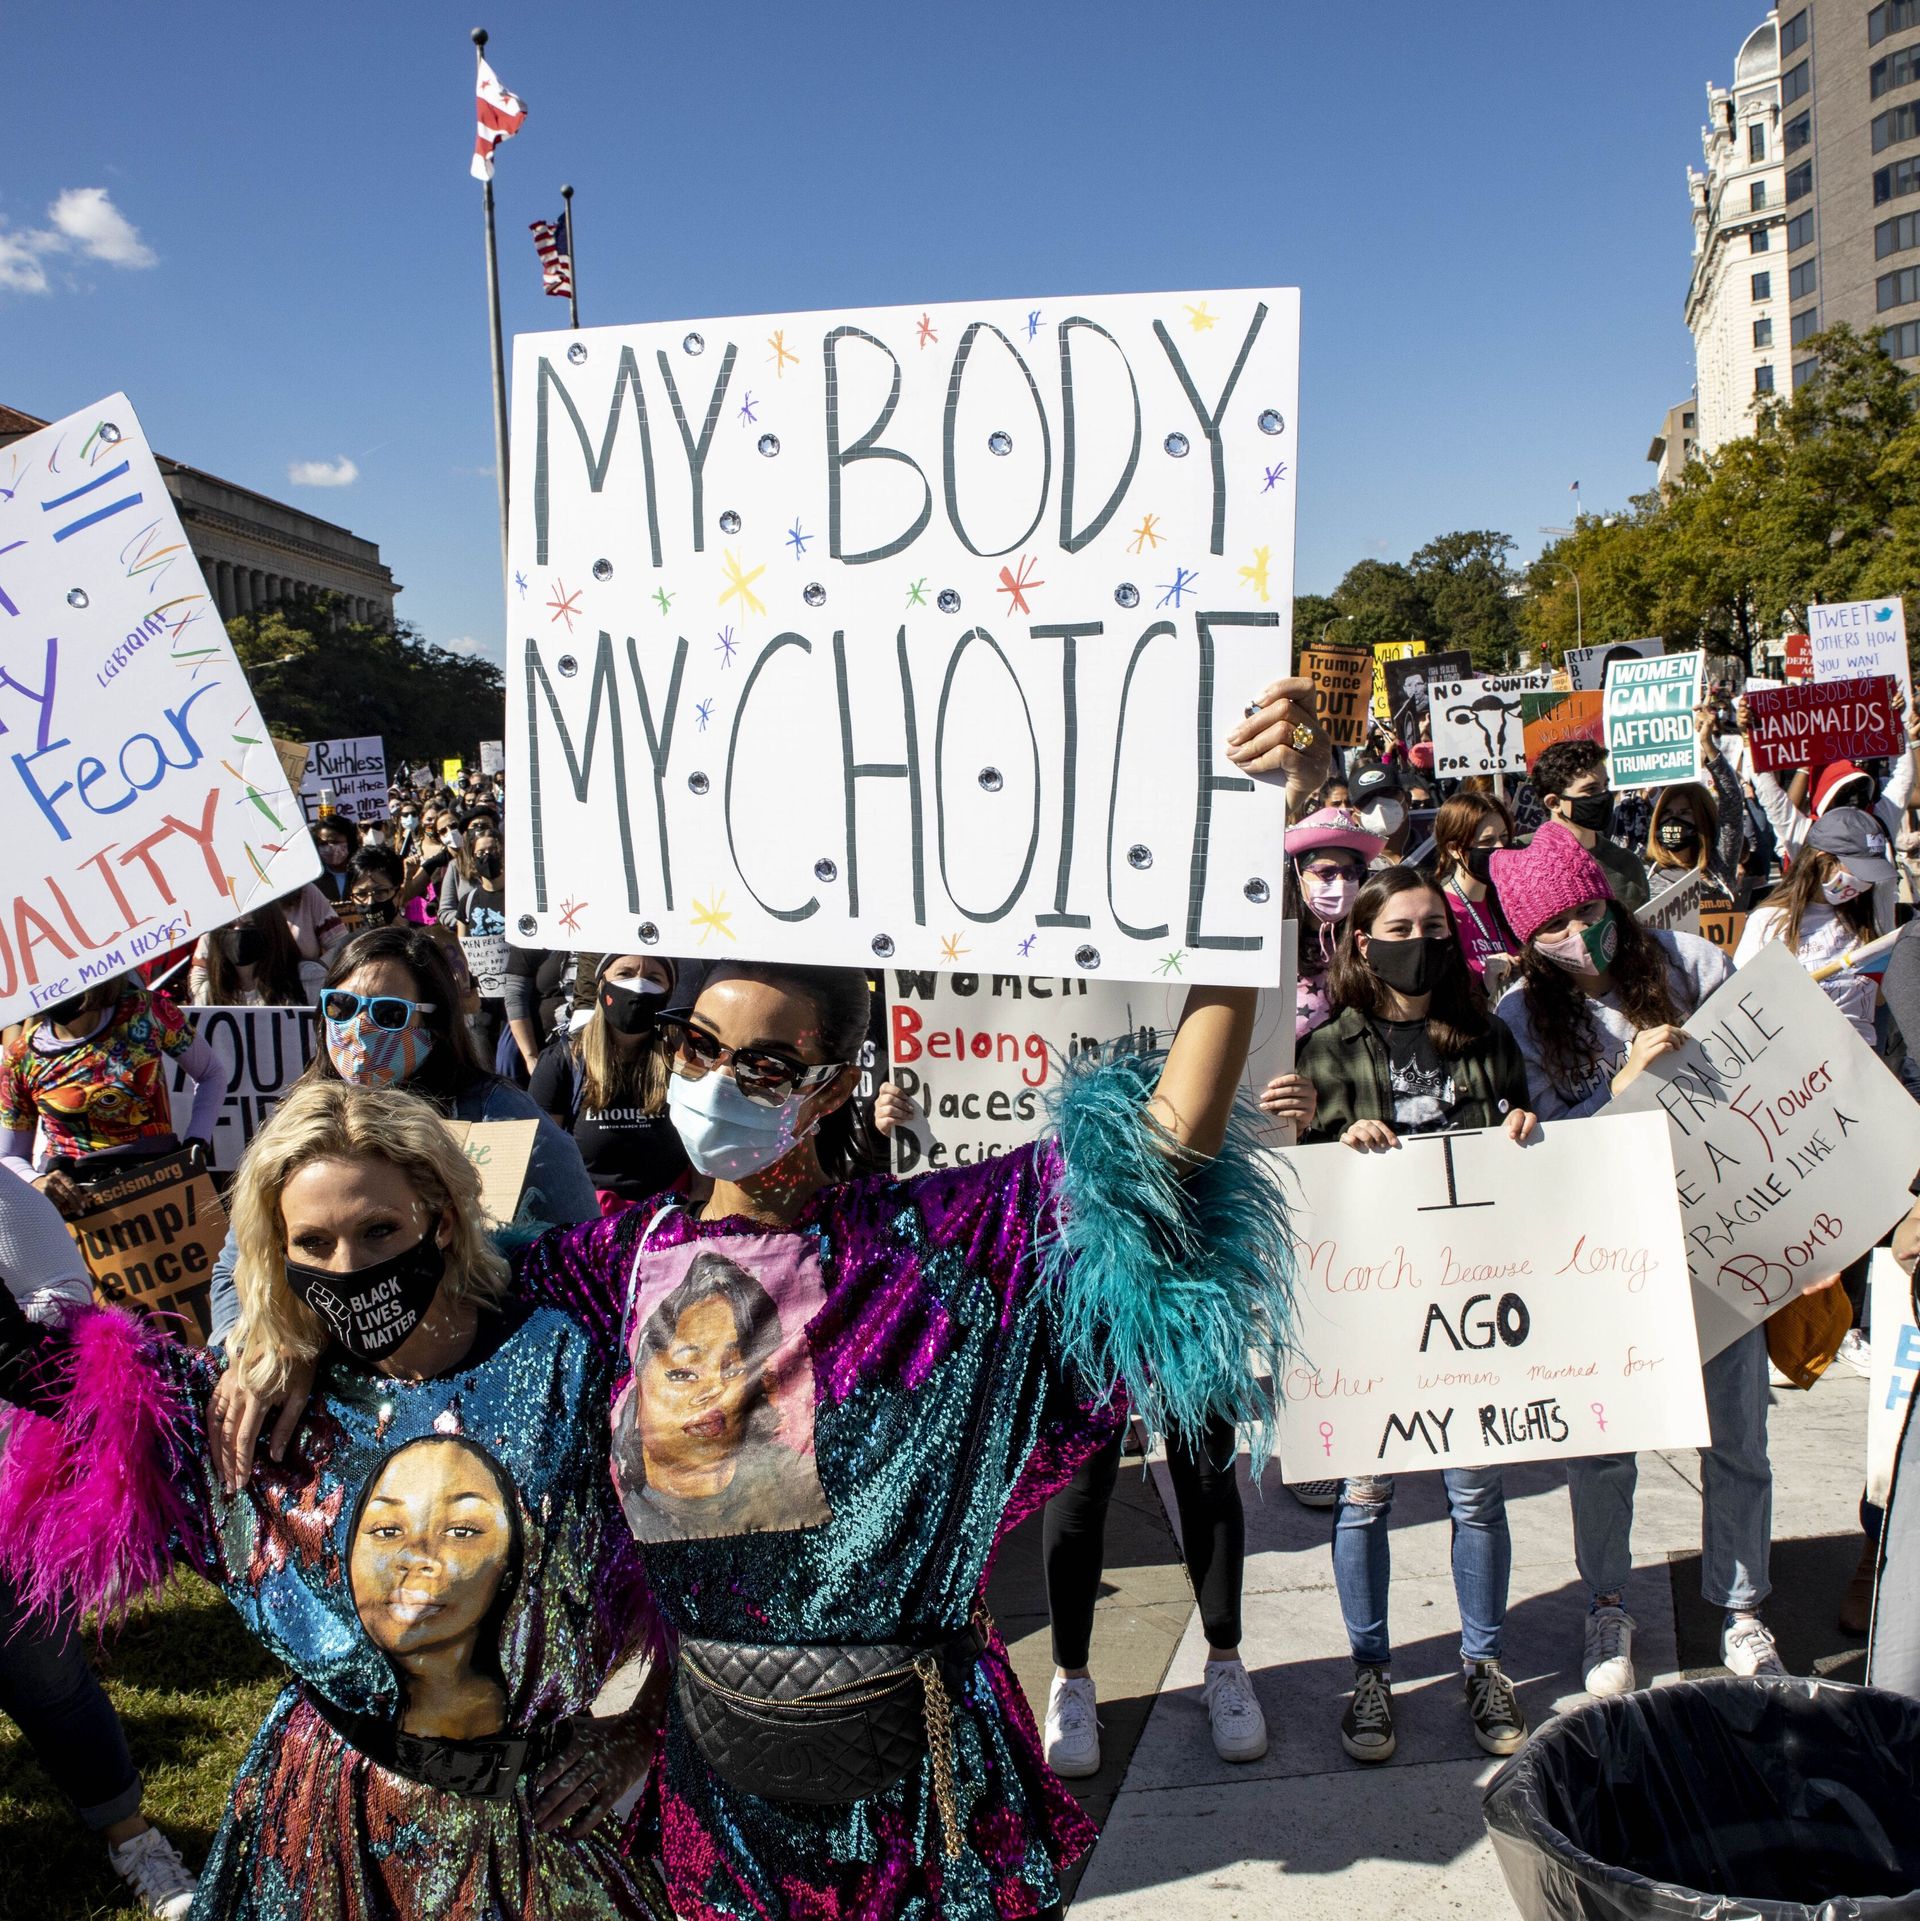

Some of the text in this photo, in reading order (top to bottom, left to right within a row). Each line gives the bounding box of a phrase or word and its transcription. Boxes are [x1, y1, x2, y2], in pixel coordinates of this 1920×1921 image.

[533, 302, 1268, 567] MY BODY
[1812, 604, 1871, 629] TWEET
[1568, 648, 1594, 664] RIP
[1816, 631, 1897, 651] OTHERS HOW
[1308, 654, 1367, 675] Trump/
[1312, 672, 1361, 690] Pence
[1615, 657, 1695, 685] WOMEN
[1817, 658, 1840, 674] YOU
[1847, 652, 1880, 668] WANT
[1434, 675, 1550, 701] NO COUNTRY
[1611, 681, 1694, 717] CAN'T
[1745, 692, 1782, 714] THIS
[1785, 680, 1856, 709] EPISODE
[1859, 678, 1876, 697] OF
[1320, 717, 1363, 743] OW!
[1612, 715, 1693, 747] AFFORD
[1752, 701, 1885, 743] HANDMAIDS
[12, 682, 221, 842] Fear
[316, 742, 383, 775] Ruthless
[1439, 754, 1526, 771] FOR OLD M
[1614, 750, 1693, 773] TRUMPCARE
[1760, 731, 1889, 766] TALE SUCKS
[524, 611, 1280, 951] MY CHOICE
[1700, 899, 1732, 909] sm.org
[30, 977, 77, 1009] Free
[78, 950, 126, 984] MOM
[891, 1004, 1050, 1088] Belong
[1655, 991, 1784, 1136] FRAGILE
[893, 1067, 1037, 1121] Places
[1786, 1128, 1836, 1180] LIKE
[1833, 1107, 1860, 1138] A
[1408, 1131, 1495, 1211] I
[84, 1184, 198, 1261] ump/
[98, 1241, 209, 1301] ence
[1440, 1245, 1536, 1287] because
[1554, 1234, 1661, 1294] long
[135, 1278, 213, 1347] UT
[350, 1276, 402, 1313] BLACK
[356, 1299, 403, 1331] LIVES
[361, 1309, 417, 1350] MATTER
[1419, 1292, 1530, 1353] AGO
[1286, 1366, 1384, 1402] Other
[1418, 1370, 1501, 1390] women
[1623, 1346, 1665, 1378] for
[1378, 1398, 1569, 1459] MY RIGHTS
